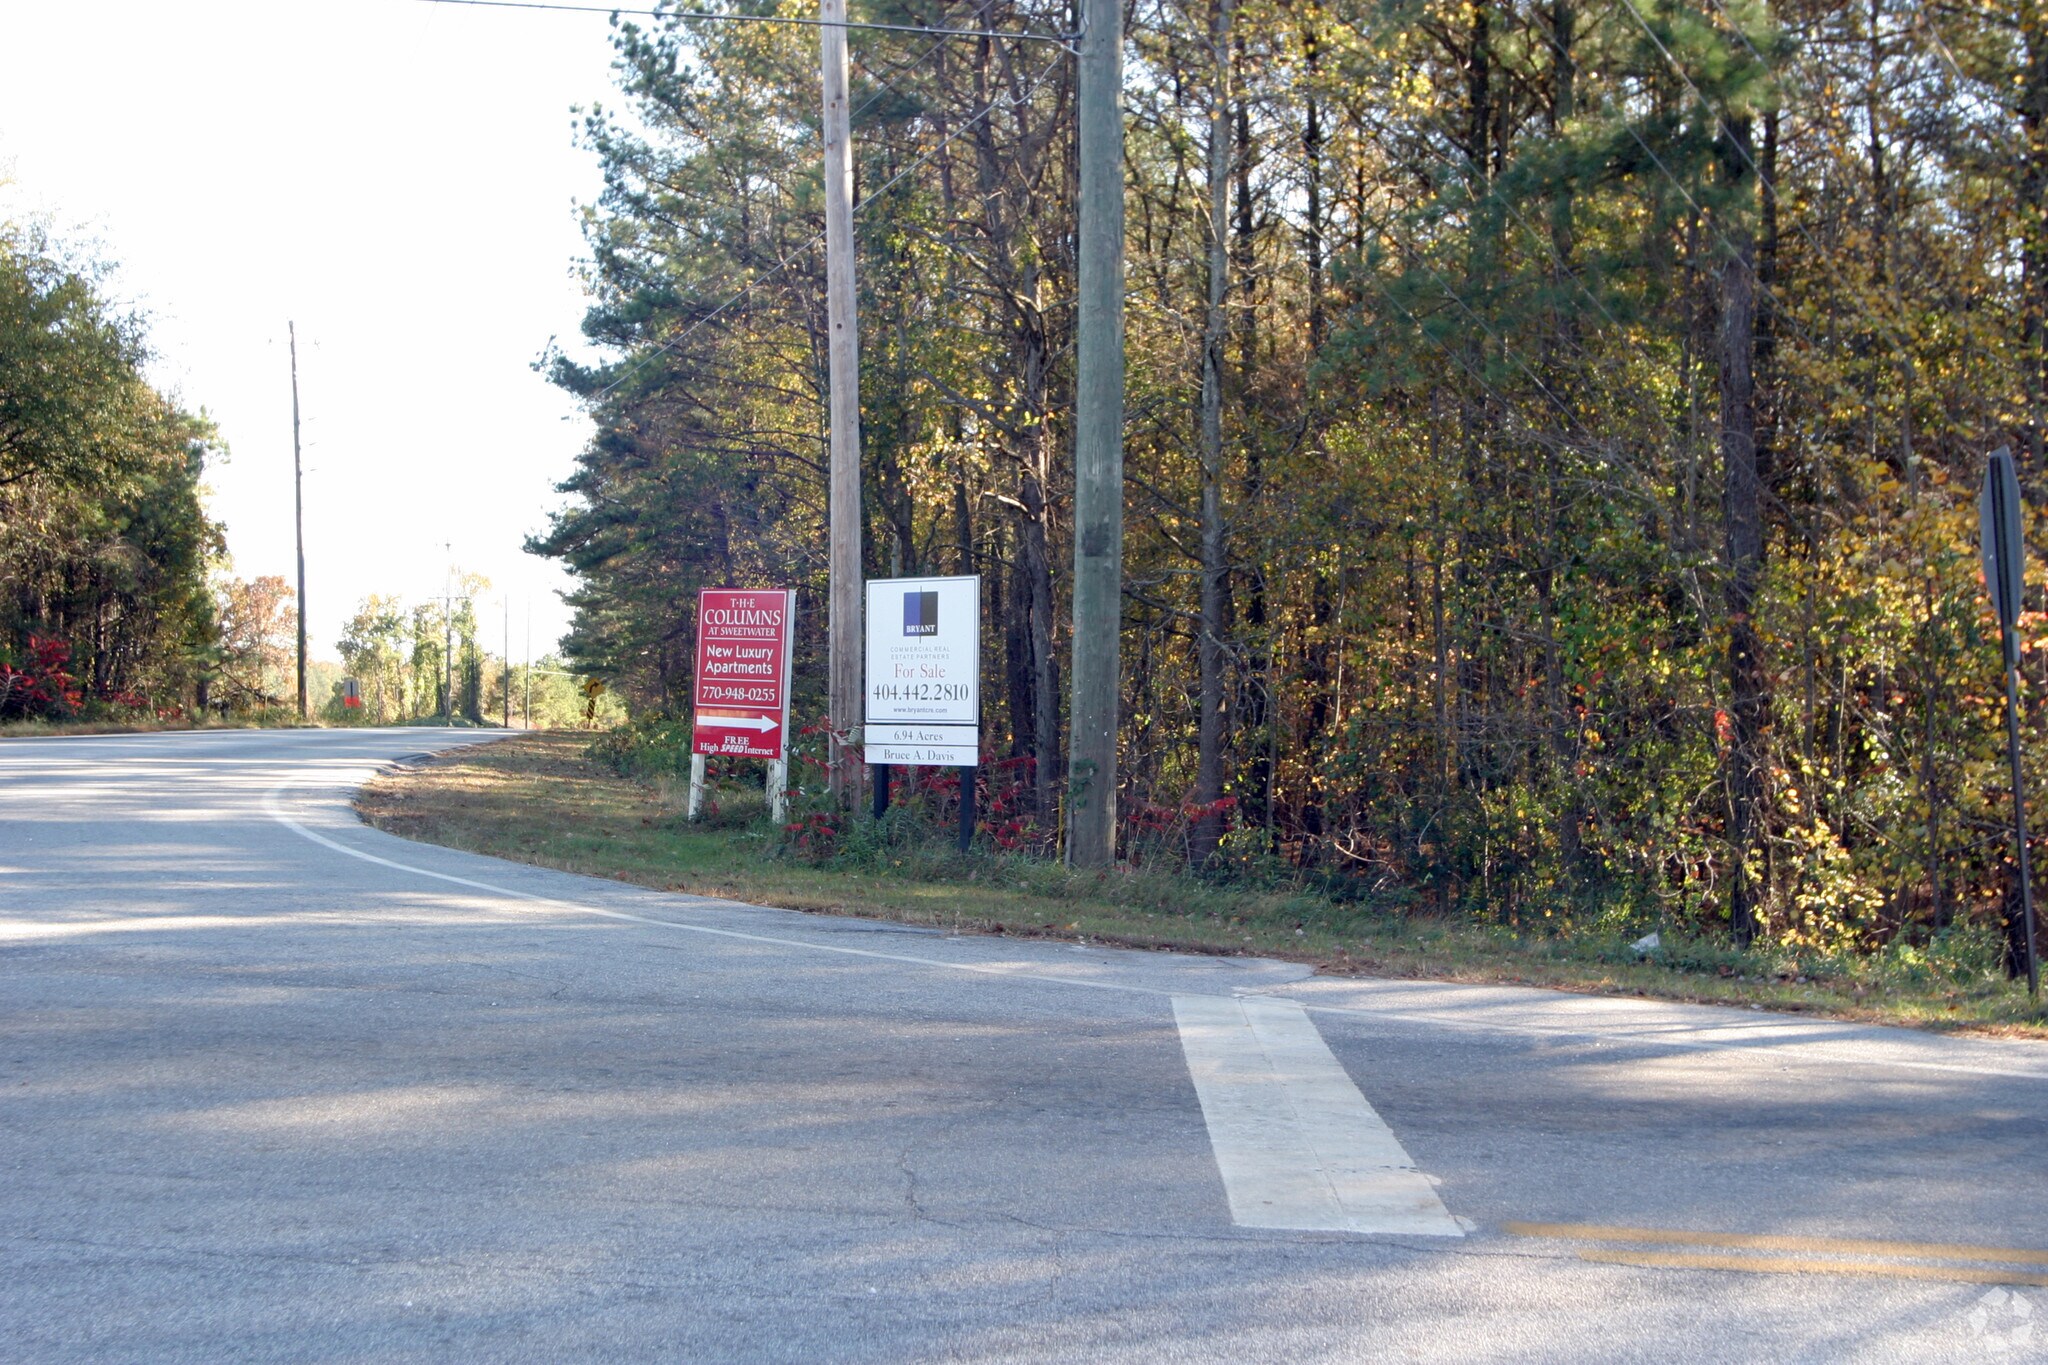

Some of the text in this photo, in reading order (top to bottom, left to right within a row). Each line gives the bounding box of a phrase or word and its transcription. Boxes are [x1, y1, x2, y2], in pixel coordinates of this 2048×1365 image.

[704, 609, 781, 626] COLUMNS
[708, 627, 775, 636] AT SWEETWATER
[706, 644, 773, 661] New Luxury
[705, 660, 772, 675] Apartments
[894, 663, 946, 679] For Sale
[703, 686, 775, 701] 770-948-0255
[873, 684, 969, 700] 404.442.2810
[725, 736, 749, 745] FREE
[893, 730, 943, 741] 6.94 Acres
[700, 742, 773, 755] High SPEED Internet
[883, 748, 954, 761] Bruce A. Davis
